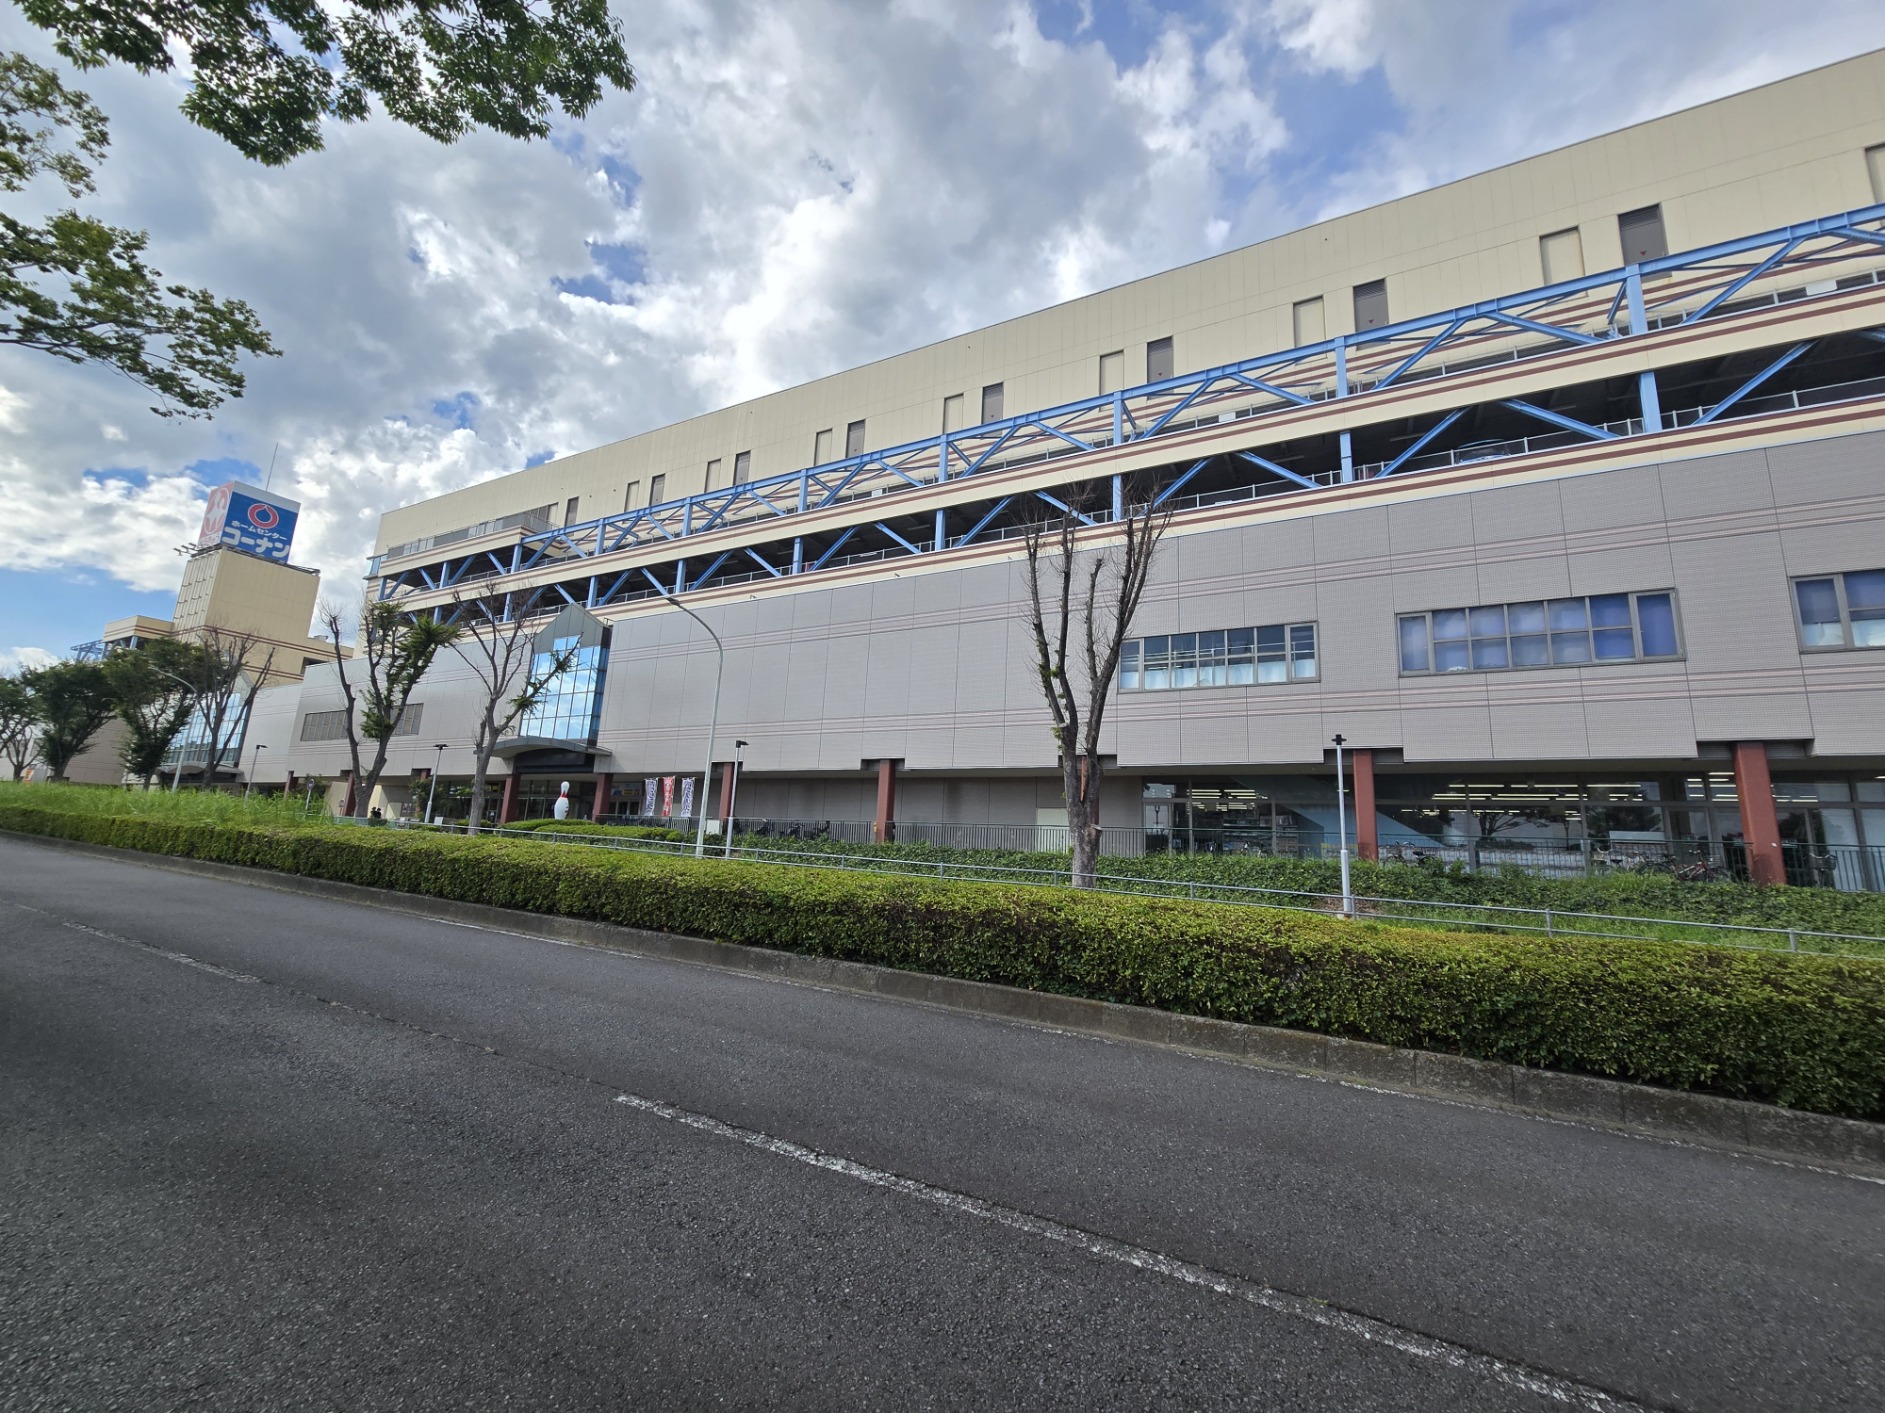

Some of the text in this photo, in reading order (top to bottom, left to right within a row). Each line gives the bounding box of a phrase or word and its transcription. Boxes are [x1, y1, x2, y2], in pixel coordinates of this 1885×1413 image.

[221, 526, 290, 558] コーナン
[231, 520, 287, 540] ホームセンター
